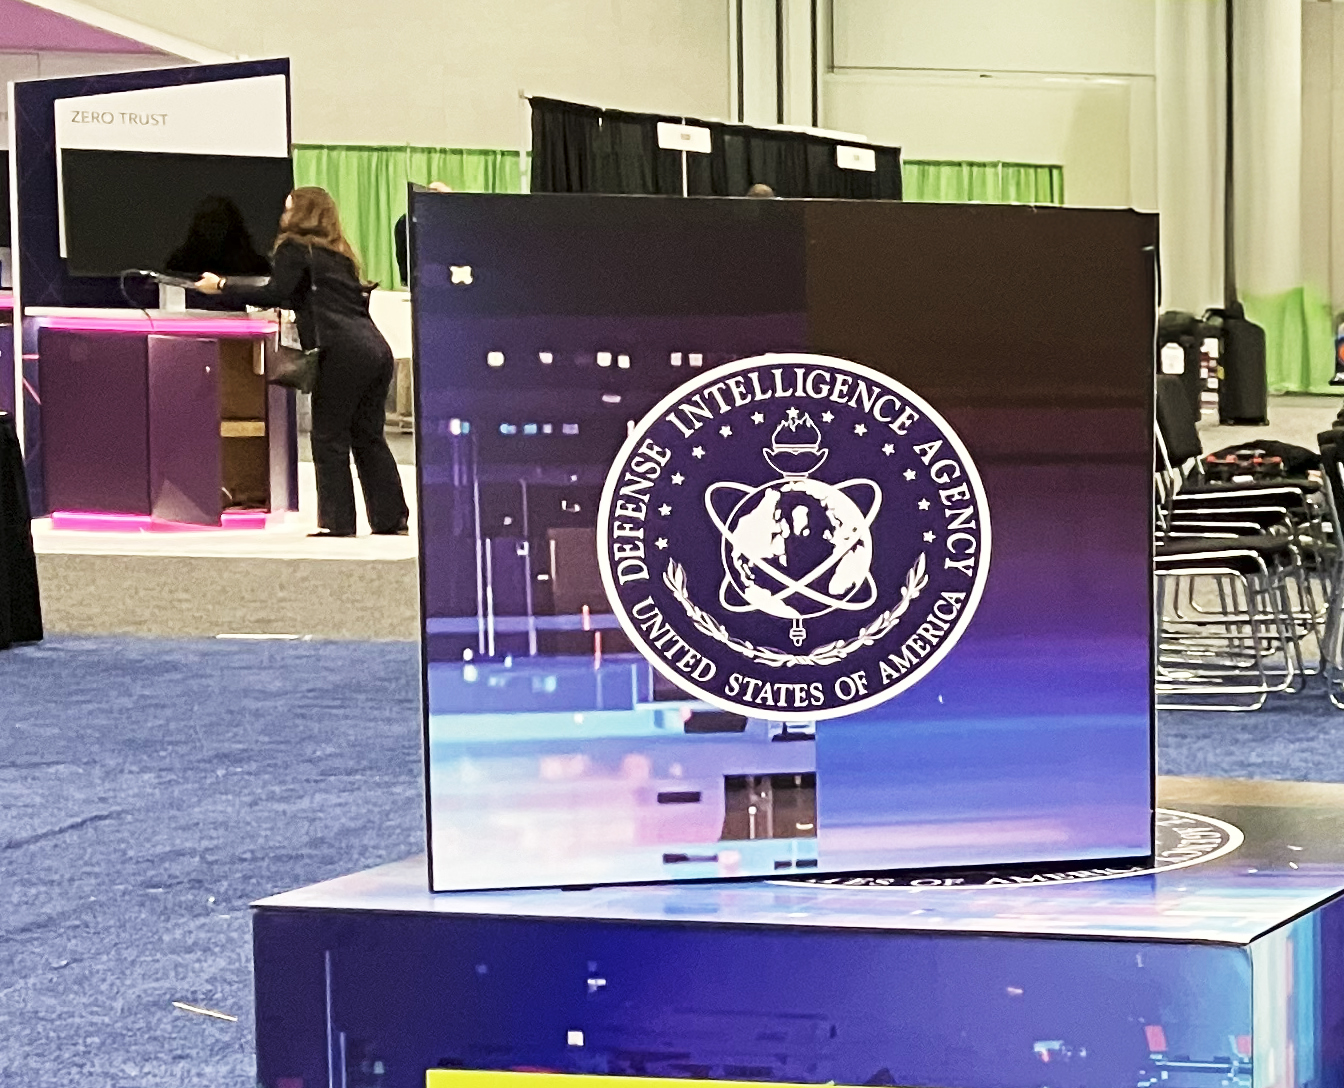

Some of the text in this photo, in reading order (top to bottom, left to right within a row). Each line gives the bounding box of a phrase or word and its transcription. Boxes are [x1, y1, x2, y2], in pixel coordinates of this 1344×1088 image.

[71, 110, 169, 126] ZERO TRUST
[613, 368, 977, 586] DEFENSE INTELLIGENCE AGENCY
[632, 590, 966, 708] UNITED STATES OF AMERICA
